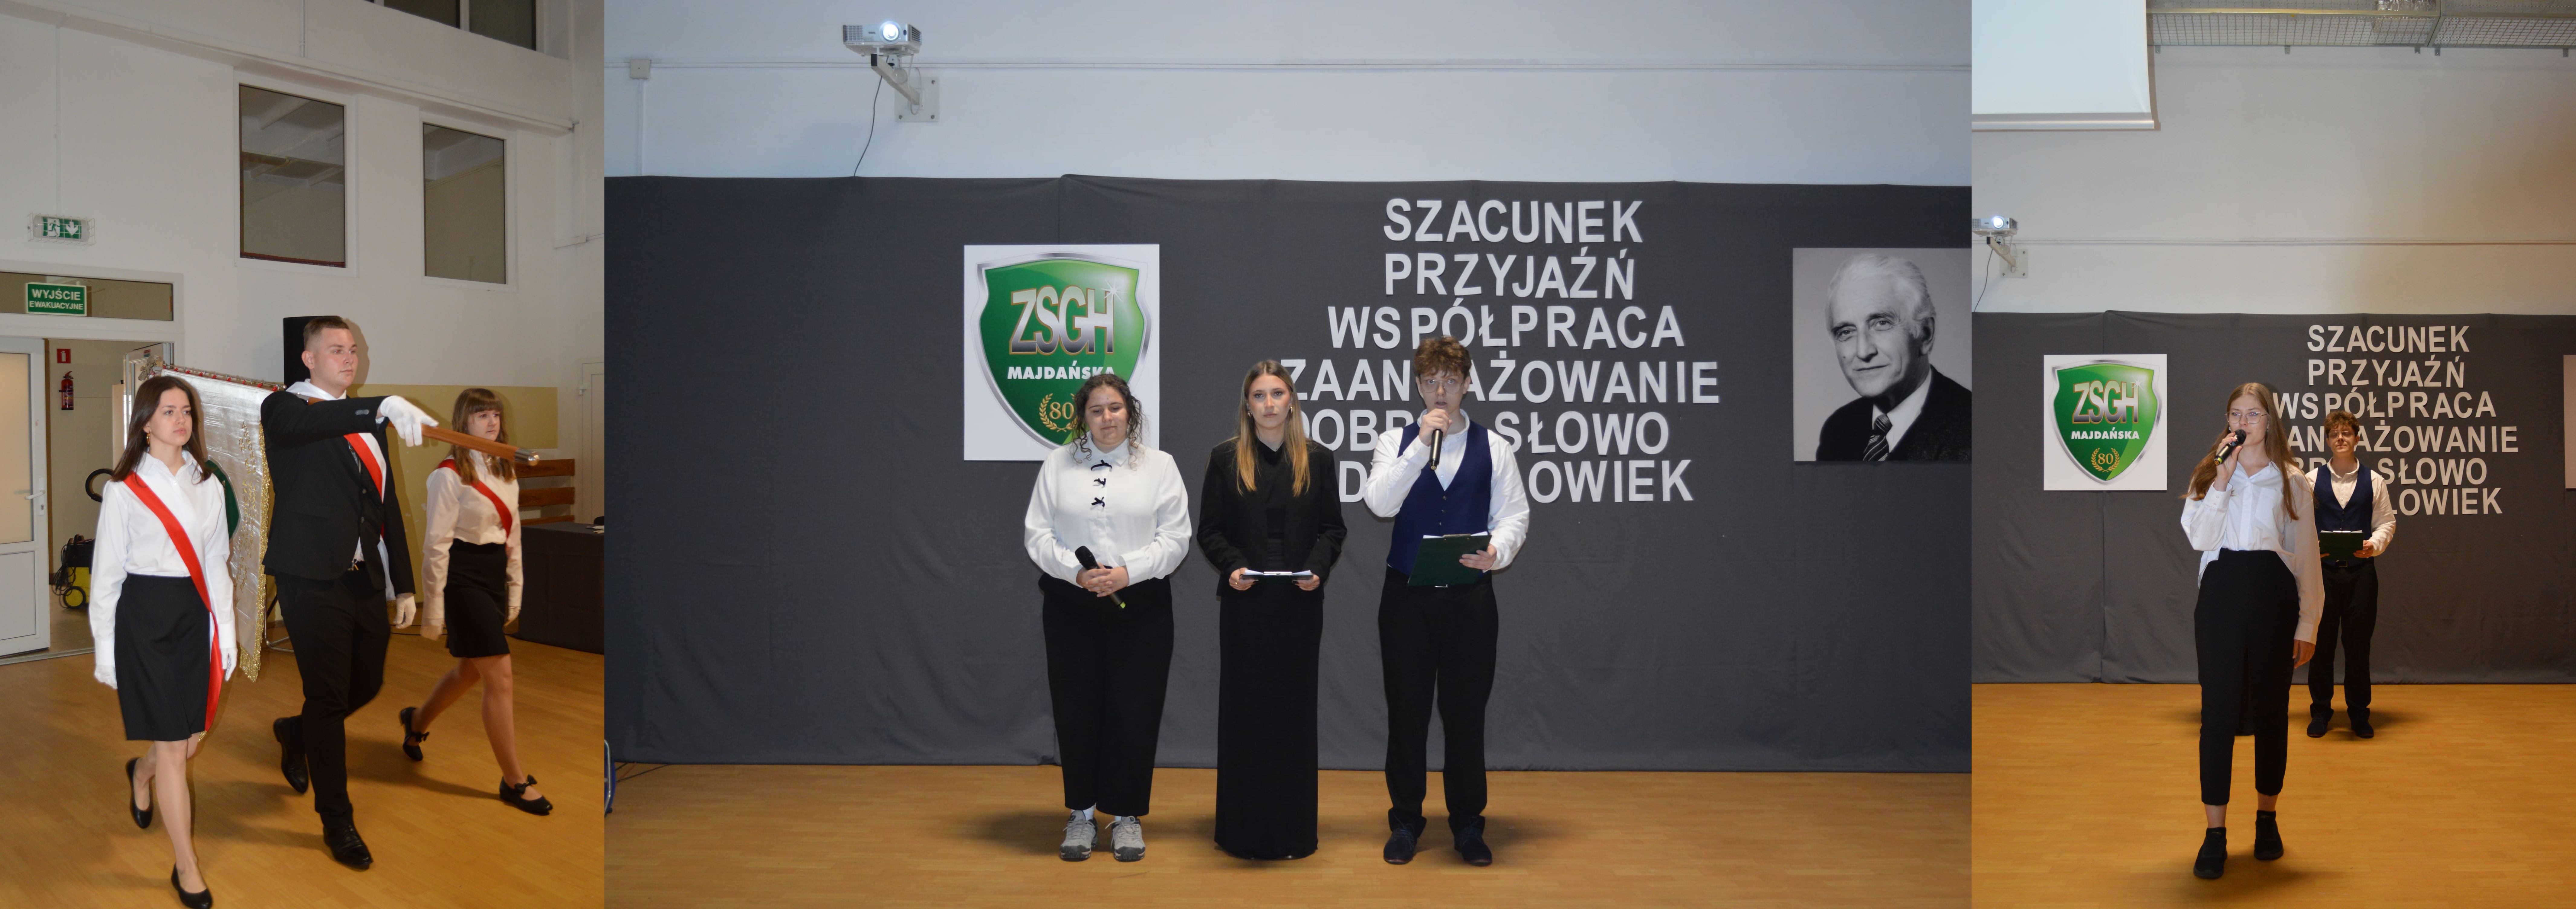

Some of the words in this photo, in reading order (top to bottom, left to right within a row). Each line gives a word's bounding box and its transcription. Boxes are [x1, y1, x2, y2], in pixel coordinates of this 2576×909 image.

[1383, 198, 1642, 244] SZACUNEK
[1386, 246, 1634, 300] PRZYJAŹŃ
[29, 301, 83, 310] EWAKUACYJNE
[31, 288, 81, 300] WYJŚCIE
[1009, 285, 1115, 356] ZSGH
[1328, 298, 1684, 349] WSPÓŁPRACA
[2307, 325, 2470, 353] SZACUNEK
[1280, 350, 1719, 403] ZAANAŻOWANIE
[2308, 354, 2464, 388] PRZYJAŹŃ
[1049, 402, 1074, 419] 80
[2072, 380, 2139, 424] ZSGH
[2273, 387, 2496, 419] WSPÓŁPRACA
[1495, 411, 1669, 455] SŁOWO
[2071, 427, 2140, 439] MAJDAŃSKA
[2287, 420, 2518, 453] ANAŻOWANIE
[2098, 453, 2113, 464] 80
[2377, 458, 2487, 485] SŁOWO
[1529, 460, 1694, 503] OWIEK
[2393, 487, 2503, 516] OWIEK
